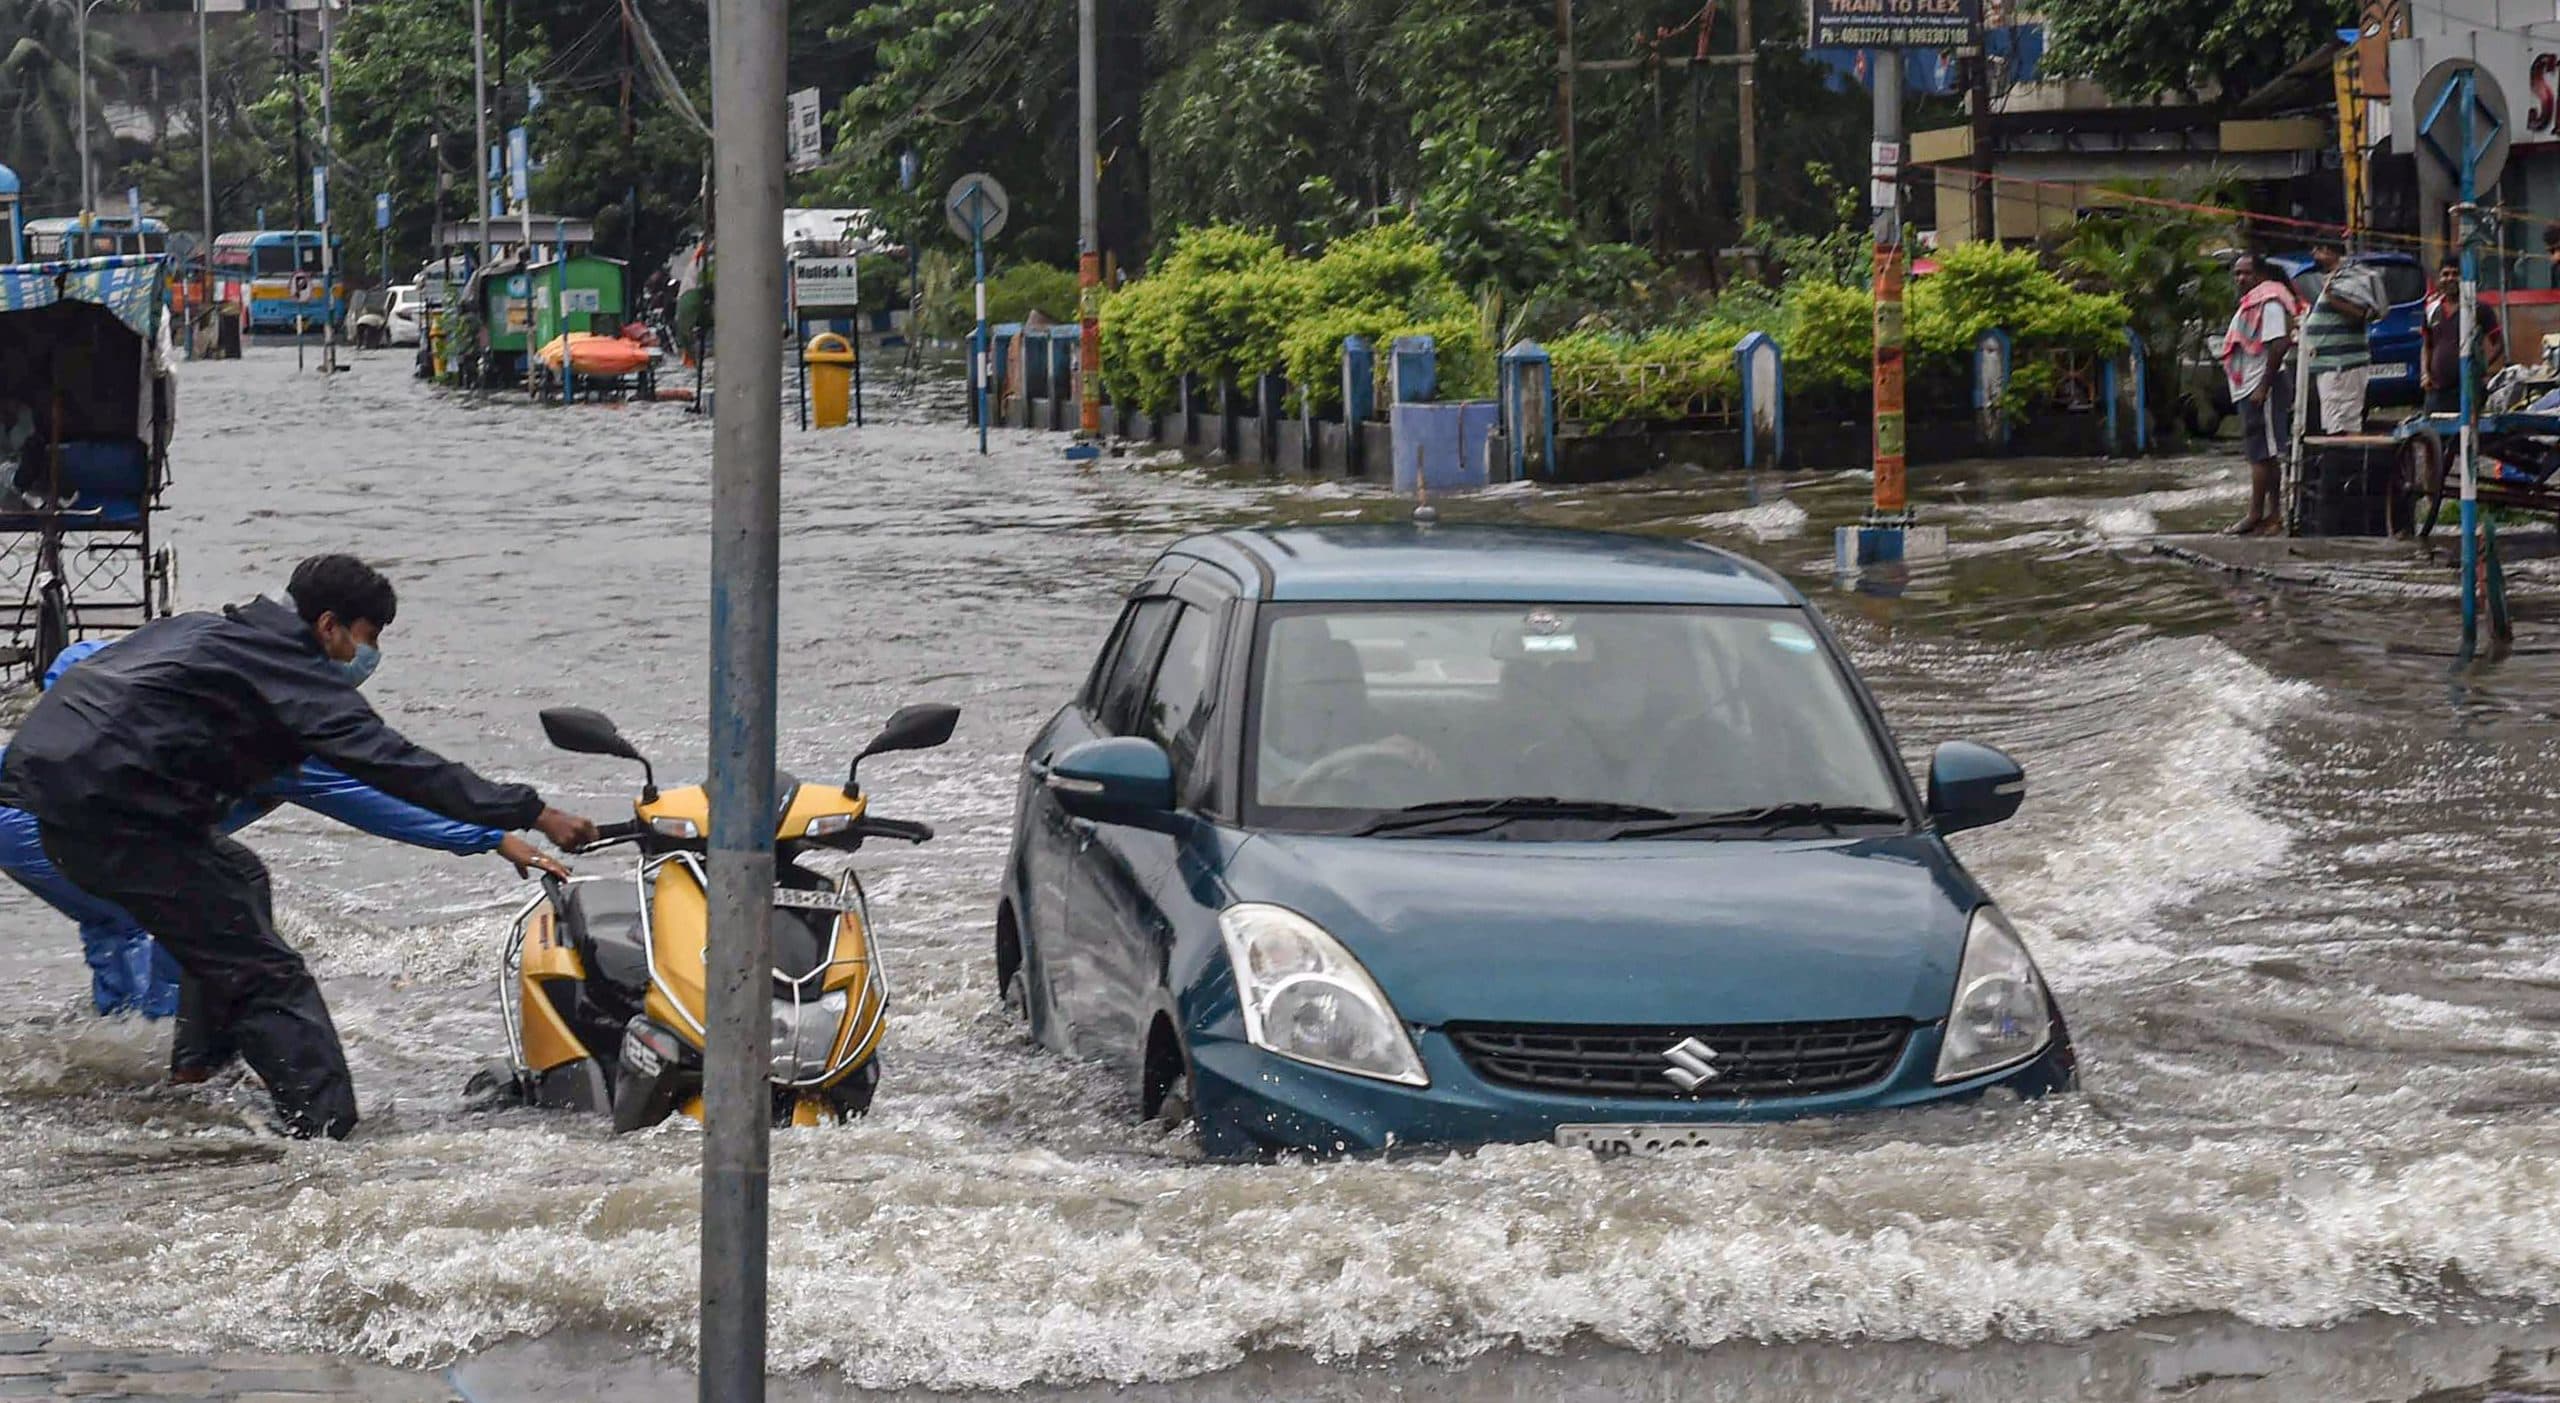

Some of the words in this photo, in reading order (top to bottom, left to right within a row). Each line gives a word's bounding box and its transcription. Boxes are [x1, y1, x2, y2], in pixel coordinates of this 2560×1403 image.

[1831, 0, 1883, 13] TRAIN
[1888, 0, 1913, 13] TO
[1918, 0, 1960, 13] FLEX
